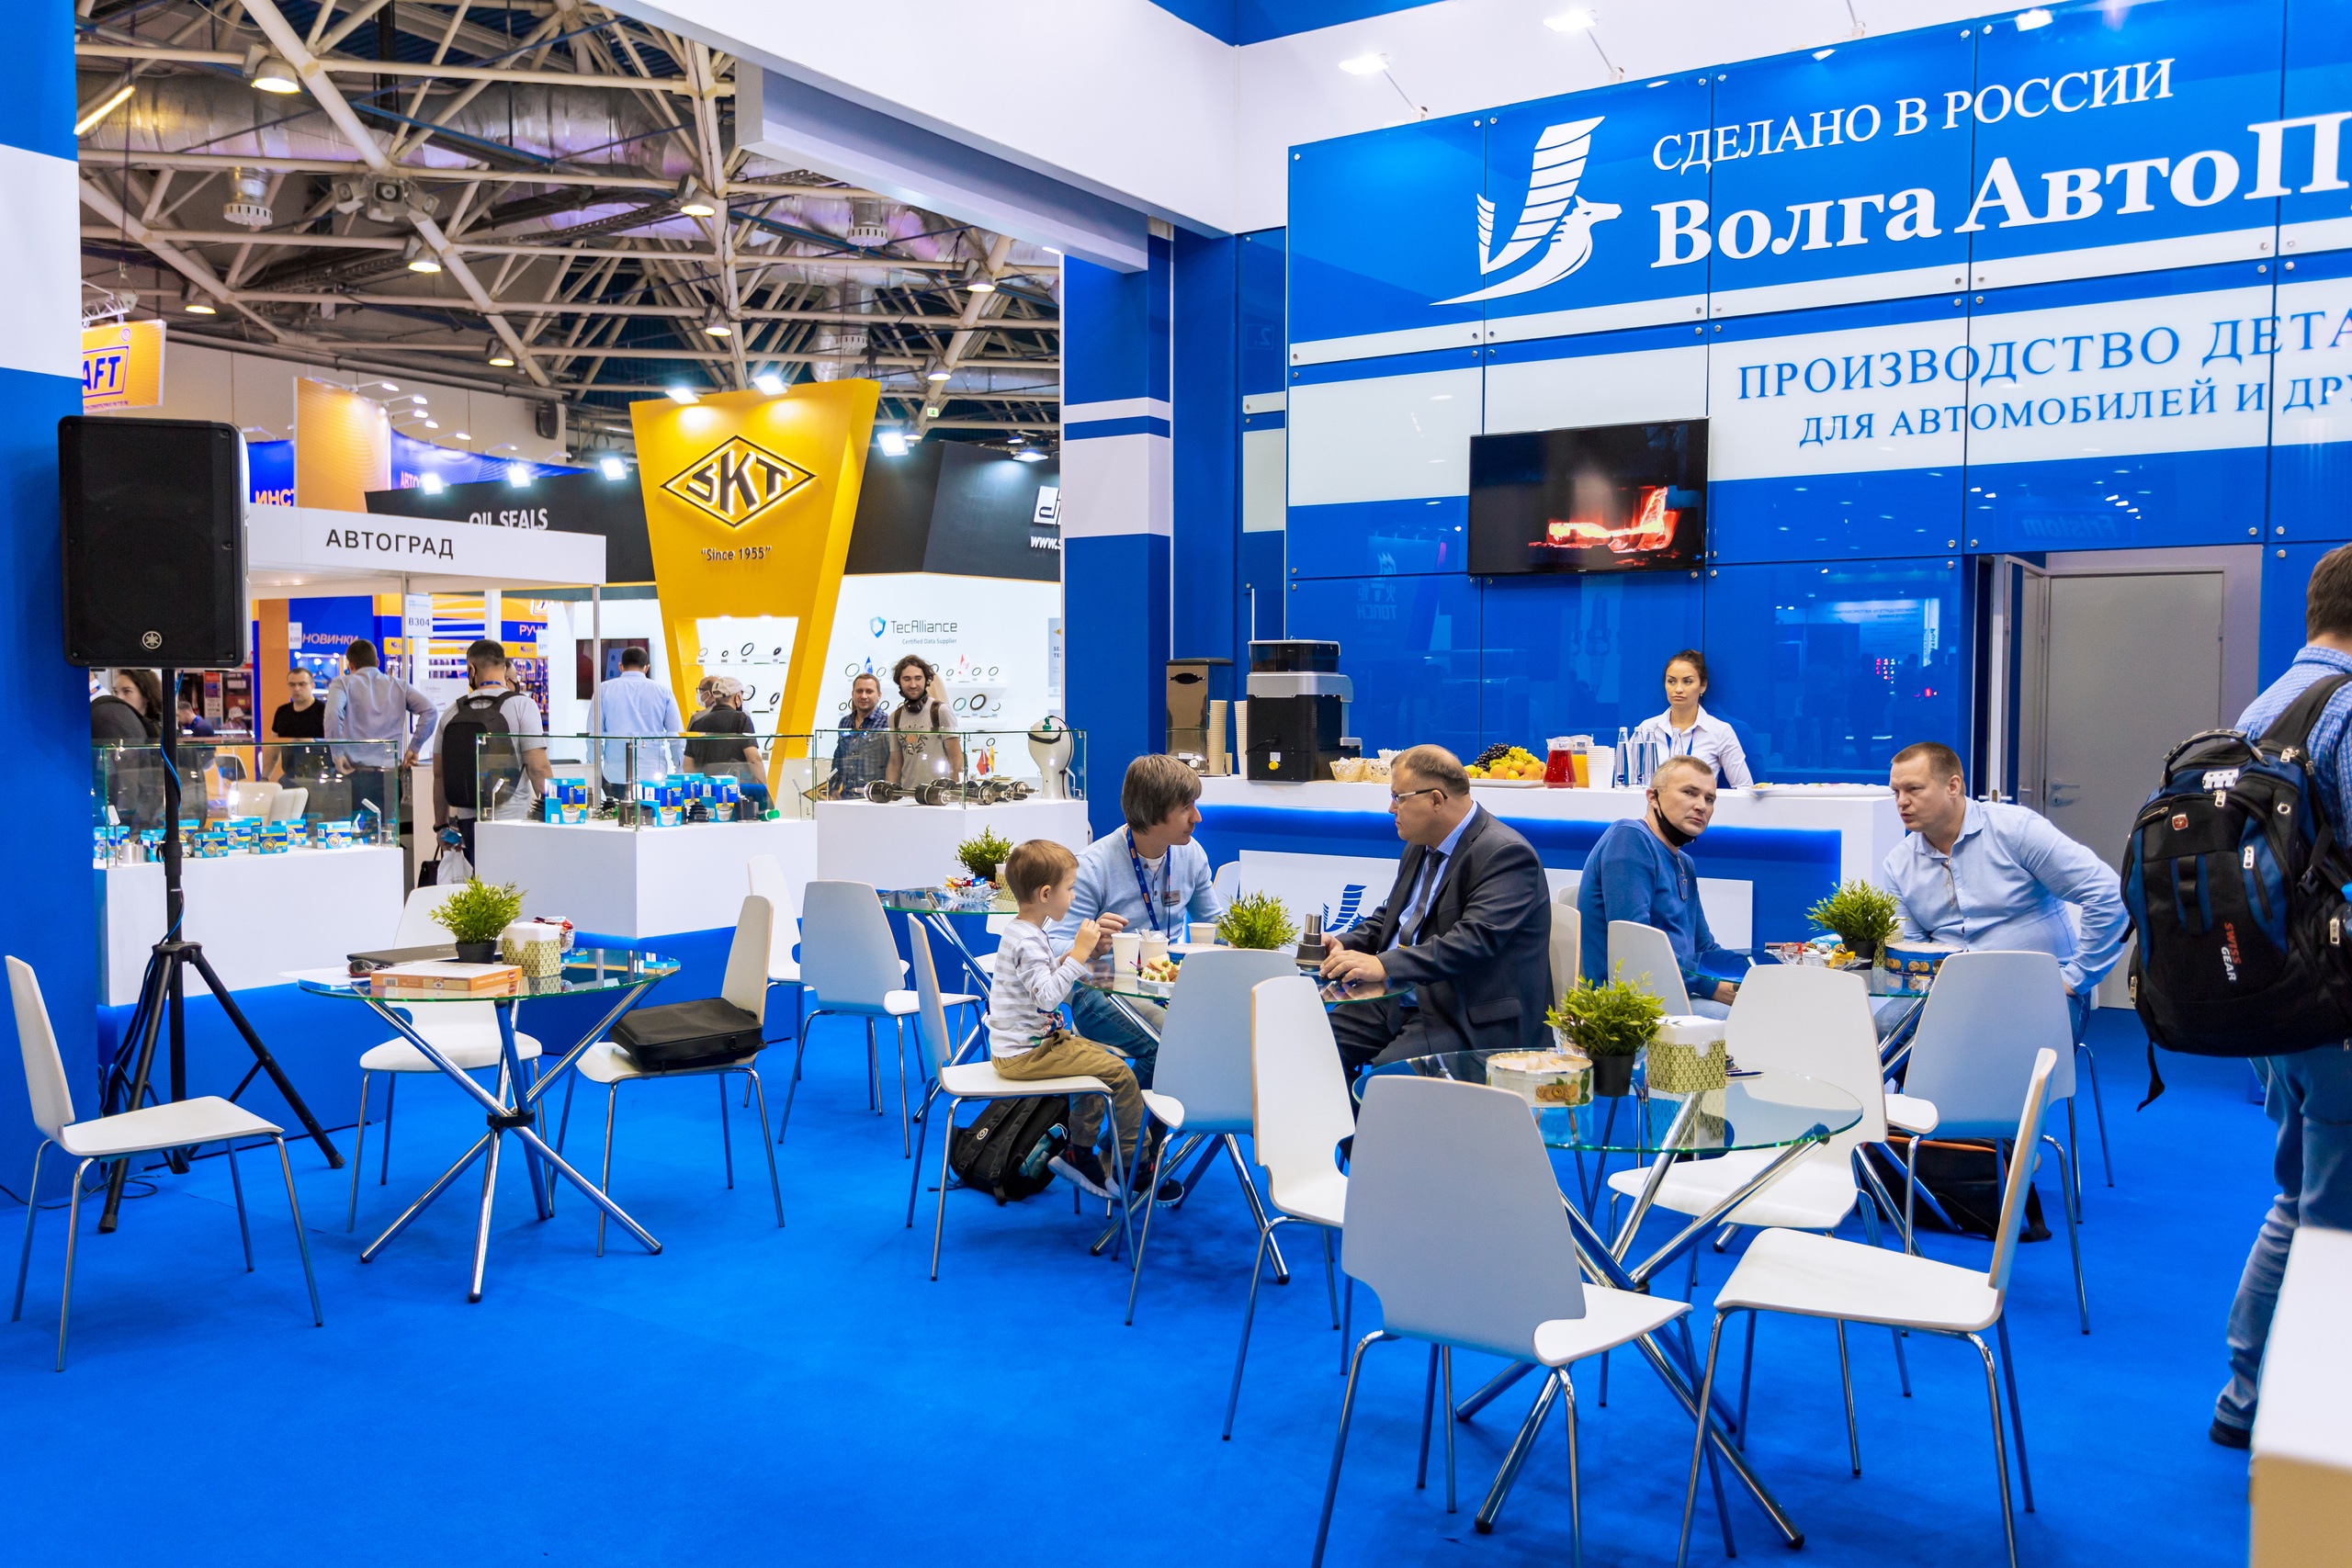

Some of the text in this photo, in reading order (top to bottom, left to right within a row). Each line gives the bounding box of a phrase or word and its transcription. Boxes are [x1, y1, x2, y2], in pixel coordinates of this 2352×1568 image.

[1652, 58, 2175, 175] СДЕЛАНО В РОССИИ
[1650, 111, 2352, 268] Волга АвтоП
[83, 355, 121, 390] AFT
[1737, 326, 2180, 400] ПРОИЗВОДСТВО
[1798, 373, 2352, 449] ДЛЯ АВТОМОБИЛЕЙ И ДР
[401, 470, 422, 489] АВТО
[685, 449, 792, 516] SKT
[326, 529, 454, 559] АВТОГРАД
[302, 633, 358, 645] НОВИНКИ
[408, 617, 430, 626] B304
[890, 619, 957, 634] TecAlliance
[936, 637, 957, 646] Supplier
[2224, 922, 2242, 964] SWISS
[2221, 946, 2238, 981] GEAR
